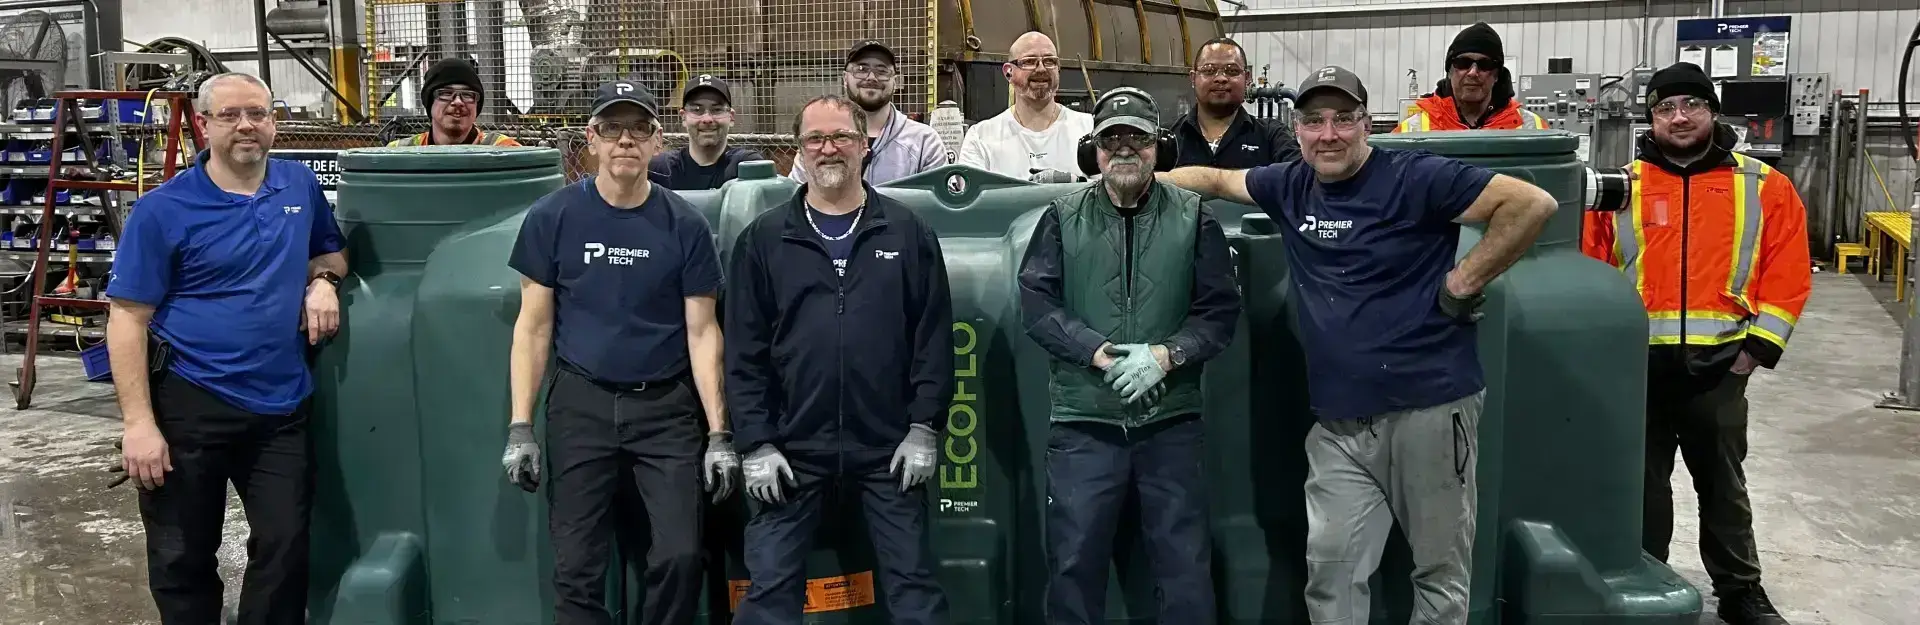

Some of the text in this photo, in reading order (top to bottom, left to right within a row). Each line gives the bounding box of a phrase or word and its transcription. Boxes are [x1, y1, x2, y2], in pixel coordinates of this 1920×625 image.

[313, 160, 327, 172] DE
[1317, 220, 1353, 229] PREMIER
[1317, 229, 1338, 239] TECH
[607, 247, 650, 258] PREMIER
[607, 256, 634, 266] TECH
